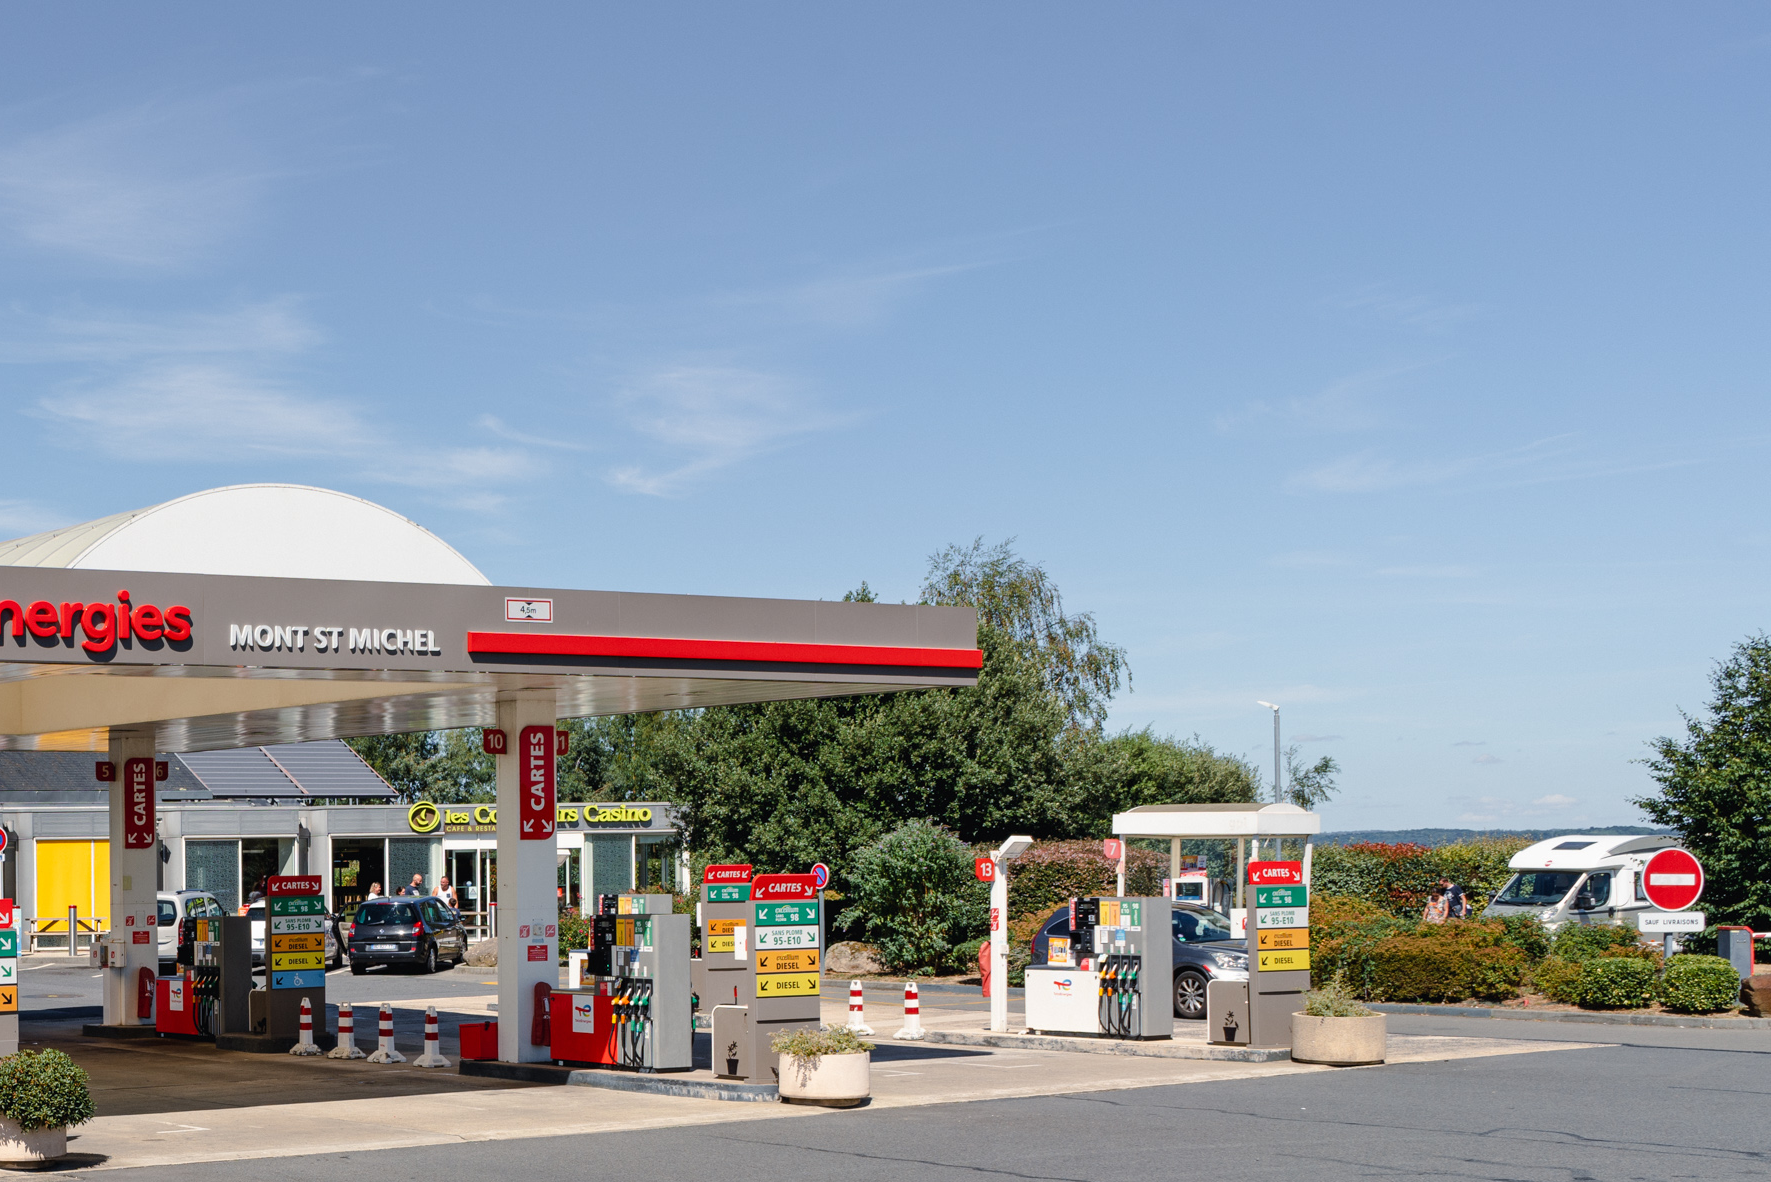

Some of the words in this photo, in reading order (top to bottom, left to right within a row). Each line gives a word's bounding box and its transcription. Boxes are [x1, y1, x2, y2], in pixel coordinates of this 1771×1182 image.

[520, 605, 537, 616] 4,5m
[230, 624, 308, 649] MONT
[314, 627, 343, 650] ST
[349, 627, 441, 653] MICHEL
[488, 734, 503, 749] 10
[102, 765, 109, 777] 5
[156, 765, 163, 777] 6
[530, 732, 545, 811] CARTES
[133, 763, 146, 826] CARTES
[444, 809, 470, 824] les
[583, 804, 652, 823] Casino
[1109, 843, 1117, 856] 7
[980, 863, 992, 877] 13
[1262, 868, 1290, 878] CARTES
[281, 881, 310, 890] CARTES
[768, 882, 802, 893] CARTES
[1284, 896, 1292, 904] 98
[790, 913, 799, 922] 98
[1271, 917, 1294, 925] 95-E10
[773, 936, 801, 945] 95-E10
[776, 962, 799, 970] DIESEL
[776, 981, 800, 989] DIESEL
